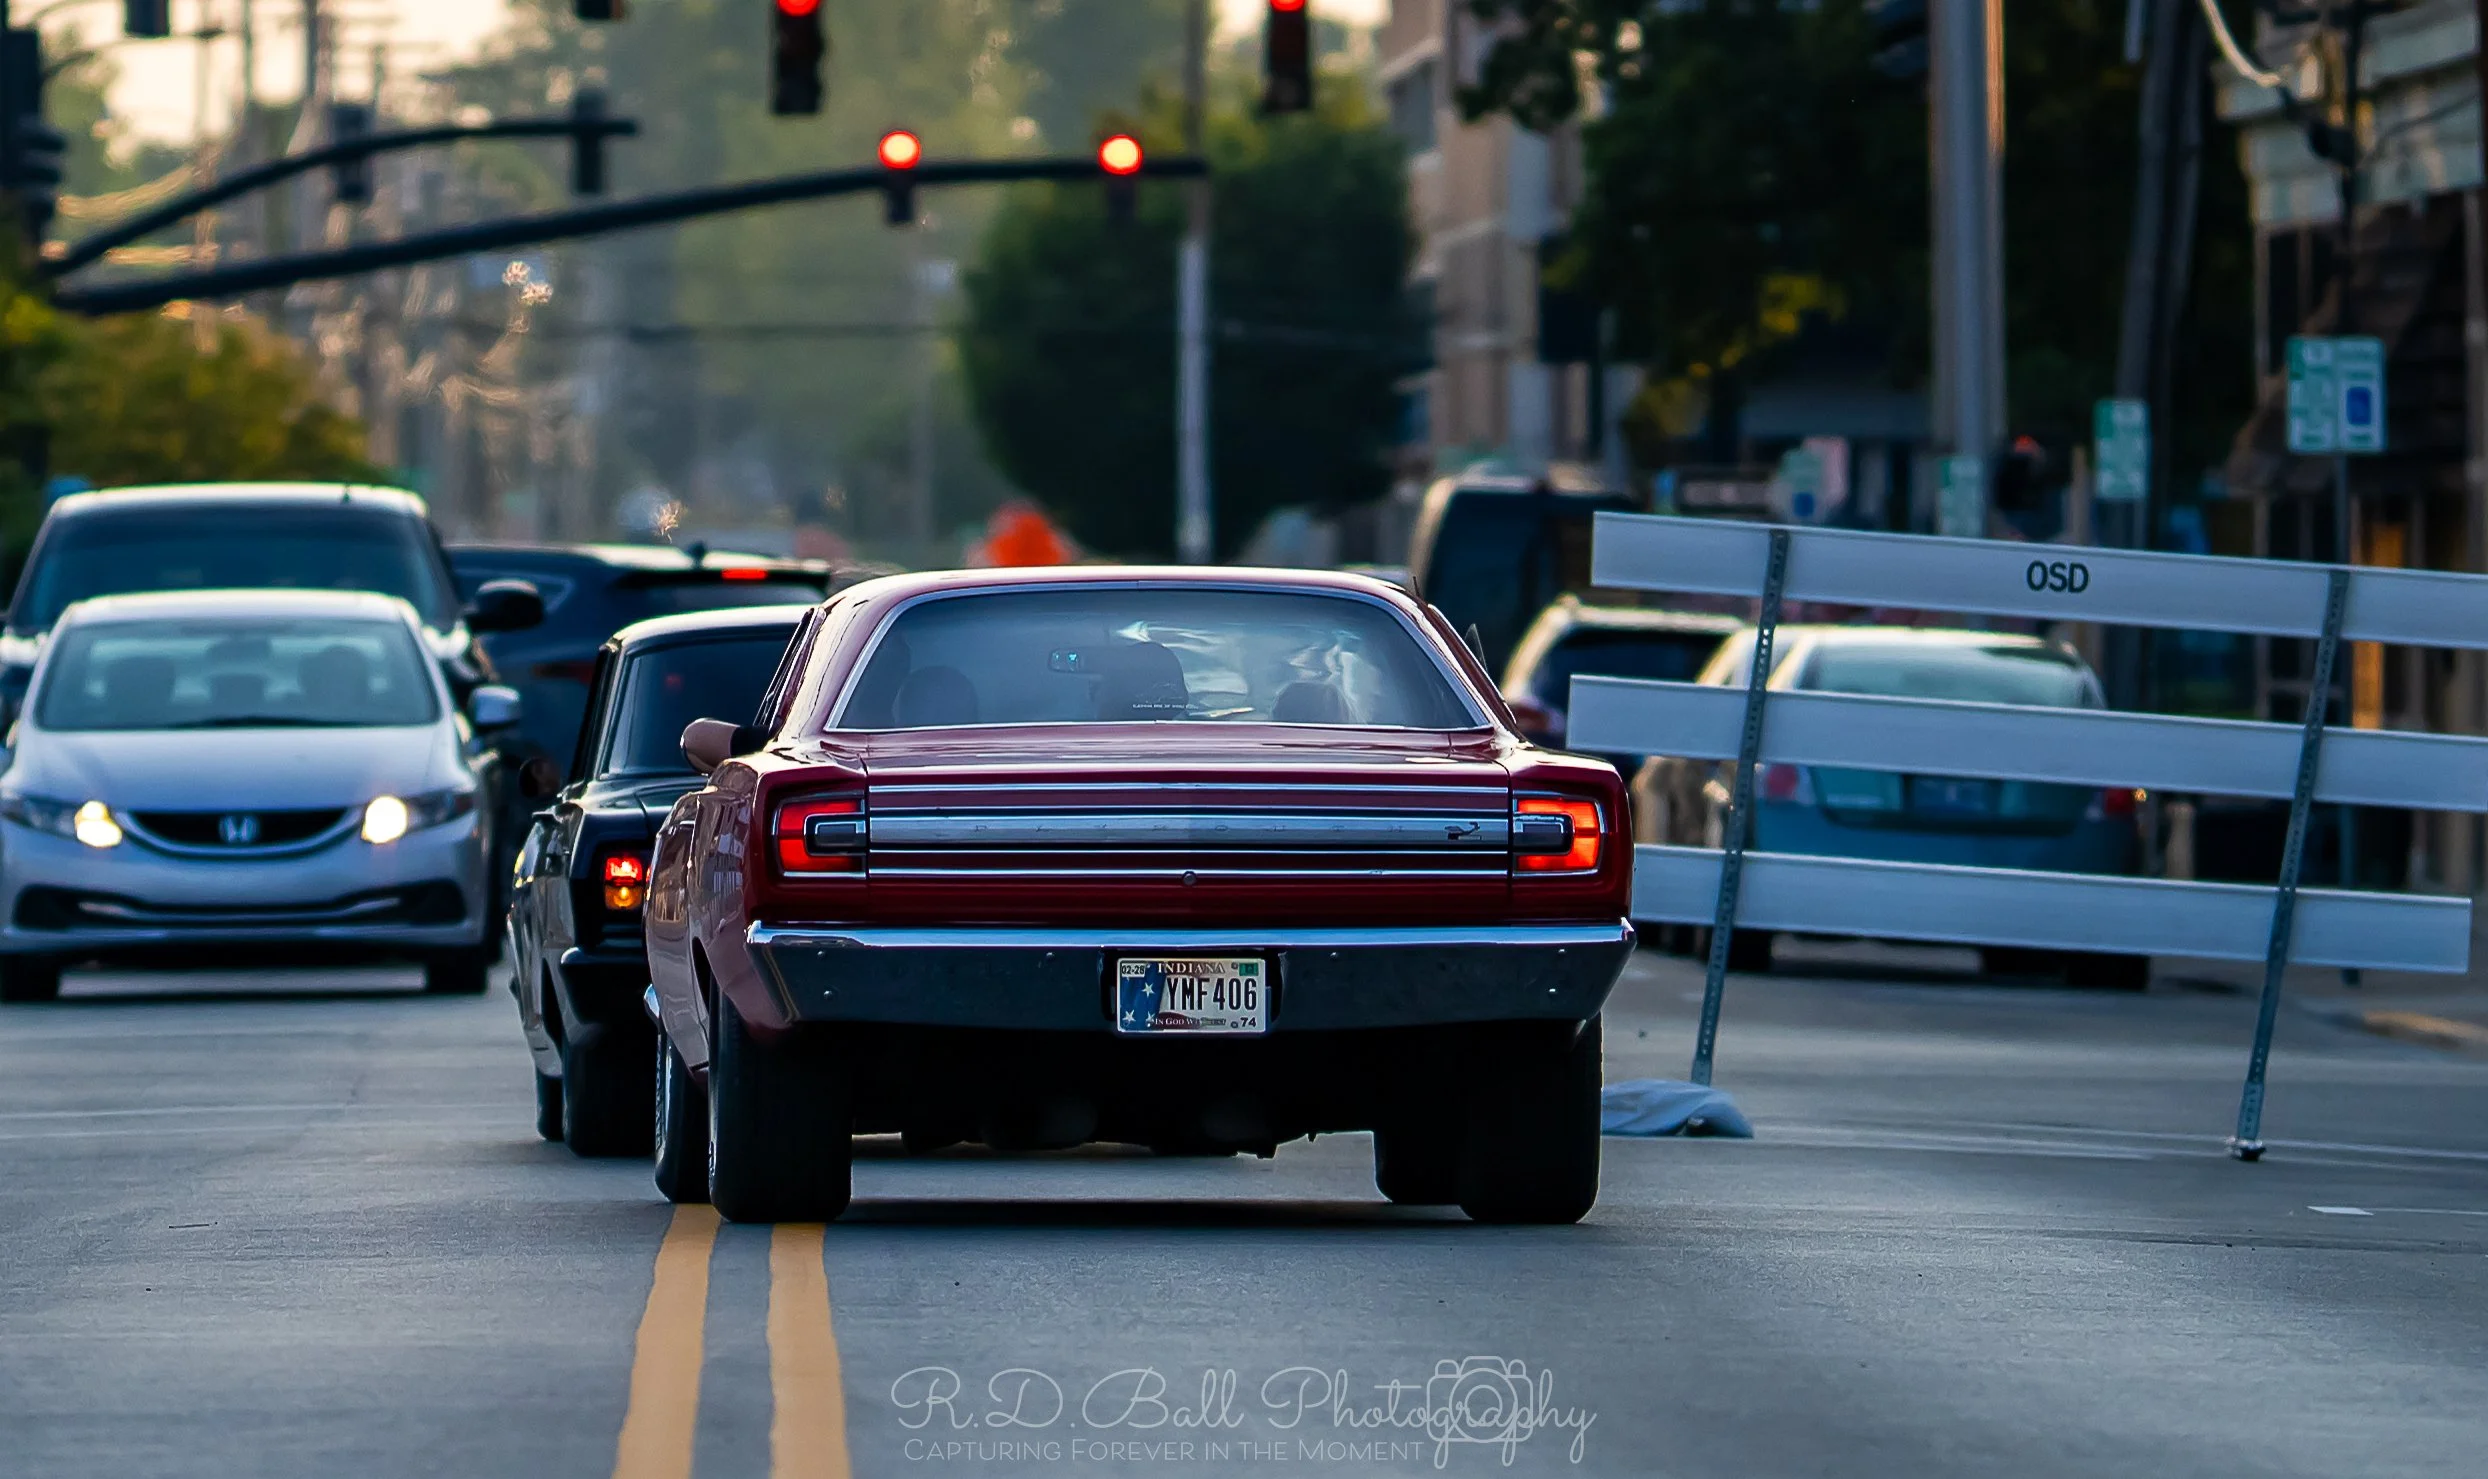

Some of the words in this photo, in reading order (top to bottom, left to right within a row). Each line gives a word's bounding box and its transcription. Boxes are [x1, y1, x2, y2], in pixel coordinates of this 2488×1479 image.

[2027, 560, 2089, 593] OSD
[1157, 961, 1226, 974] INDIANA
[1167, 977, 1257, 1011] YMF406
[1240, 1017, 1257, 1028] 74
